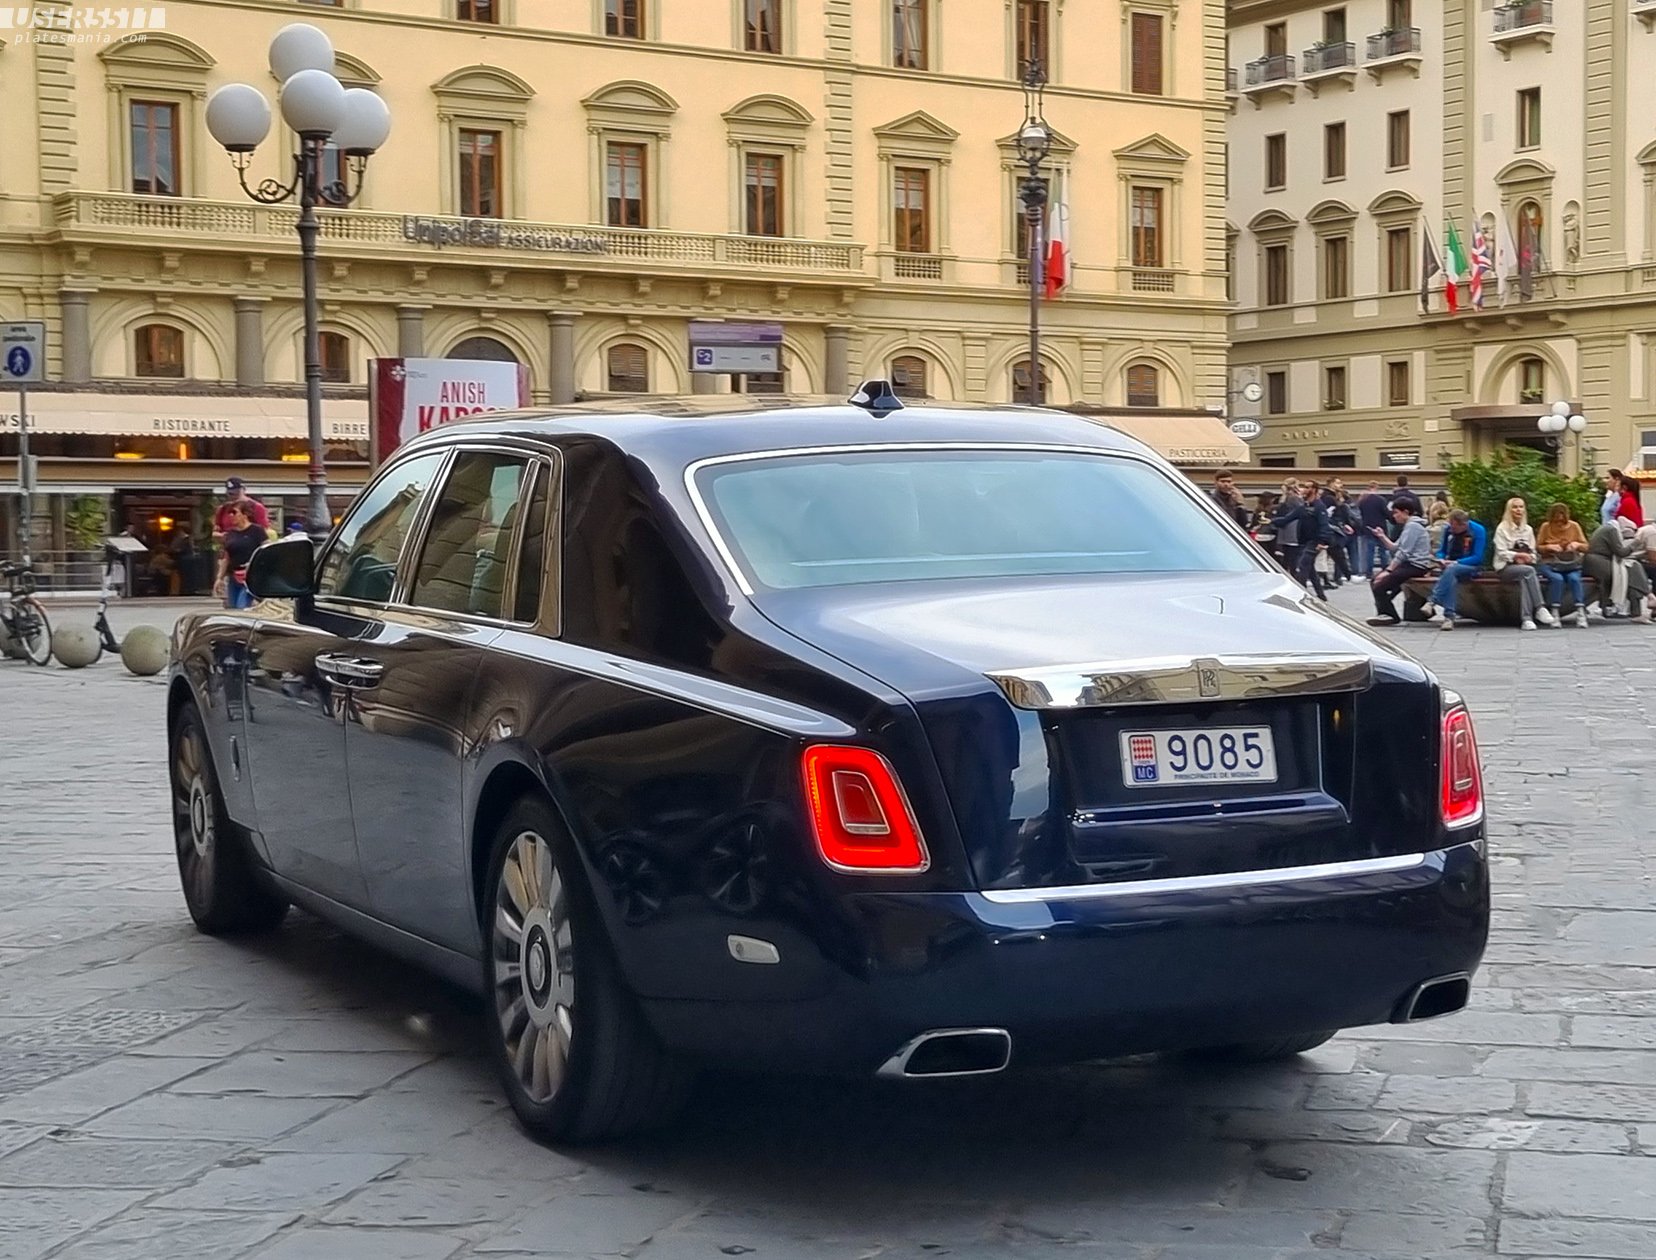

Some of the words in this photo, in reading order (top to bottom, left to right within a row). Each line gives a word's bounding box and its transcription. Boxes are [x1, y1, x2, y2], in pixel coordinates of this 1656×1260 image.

[440, 381, 486, 404] ANISH
[153, 418, 231, 432] RISTORANTE
[1168, 448, 1228, 458] PASTICCERIA
[1167, 732, 1264, 772] 9085
[1136, 766, 1154, 779] MC
